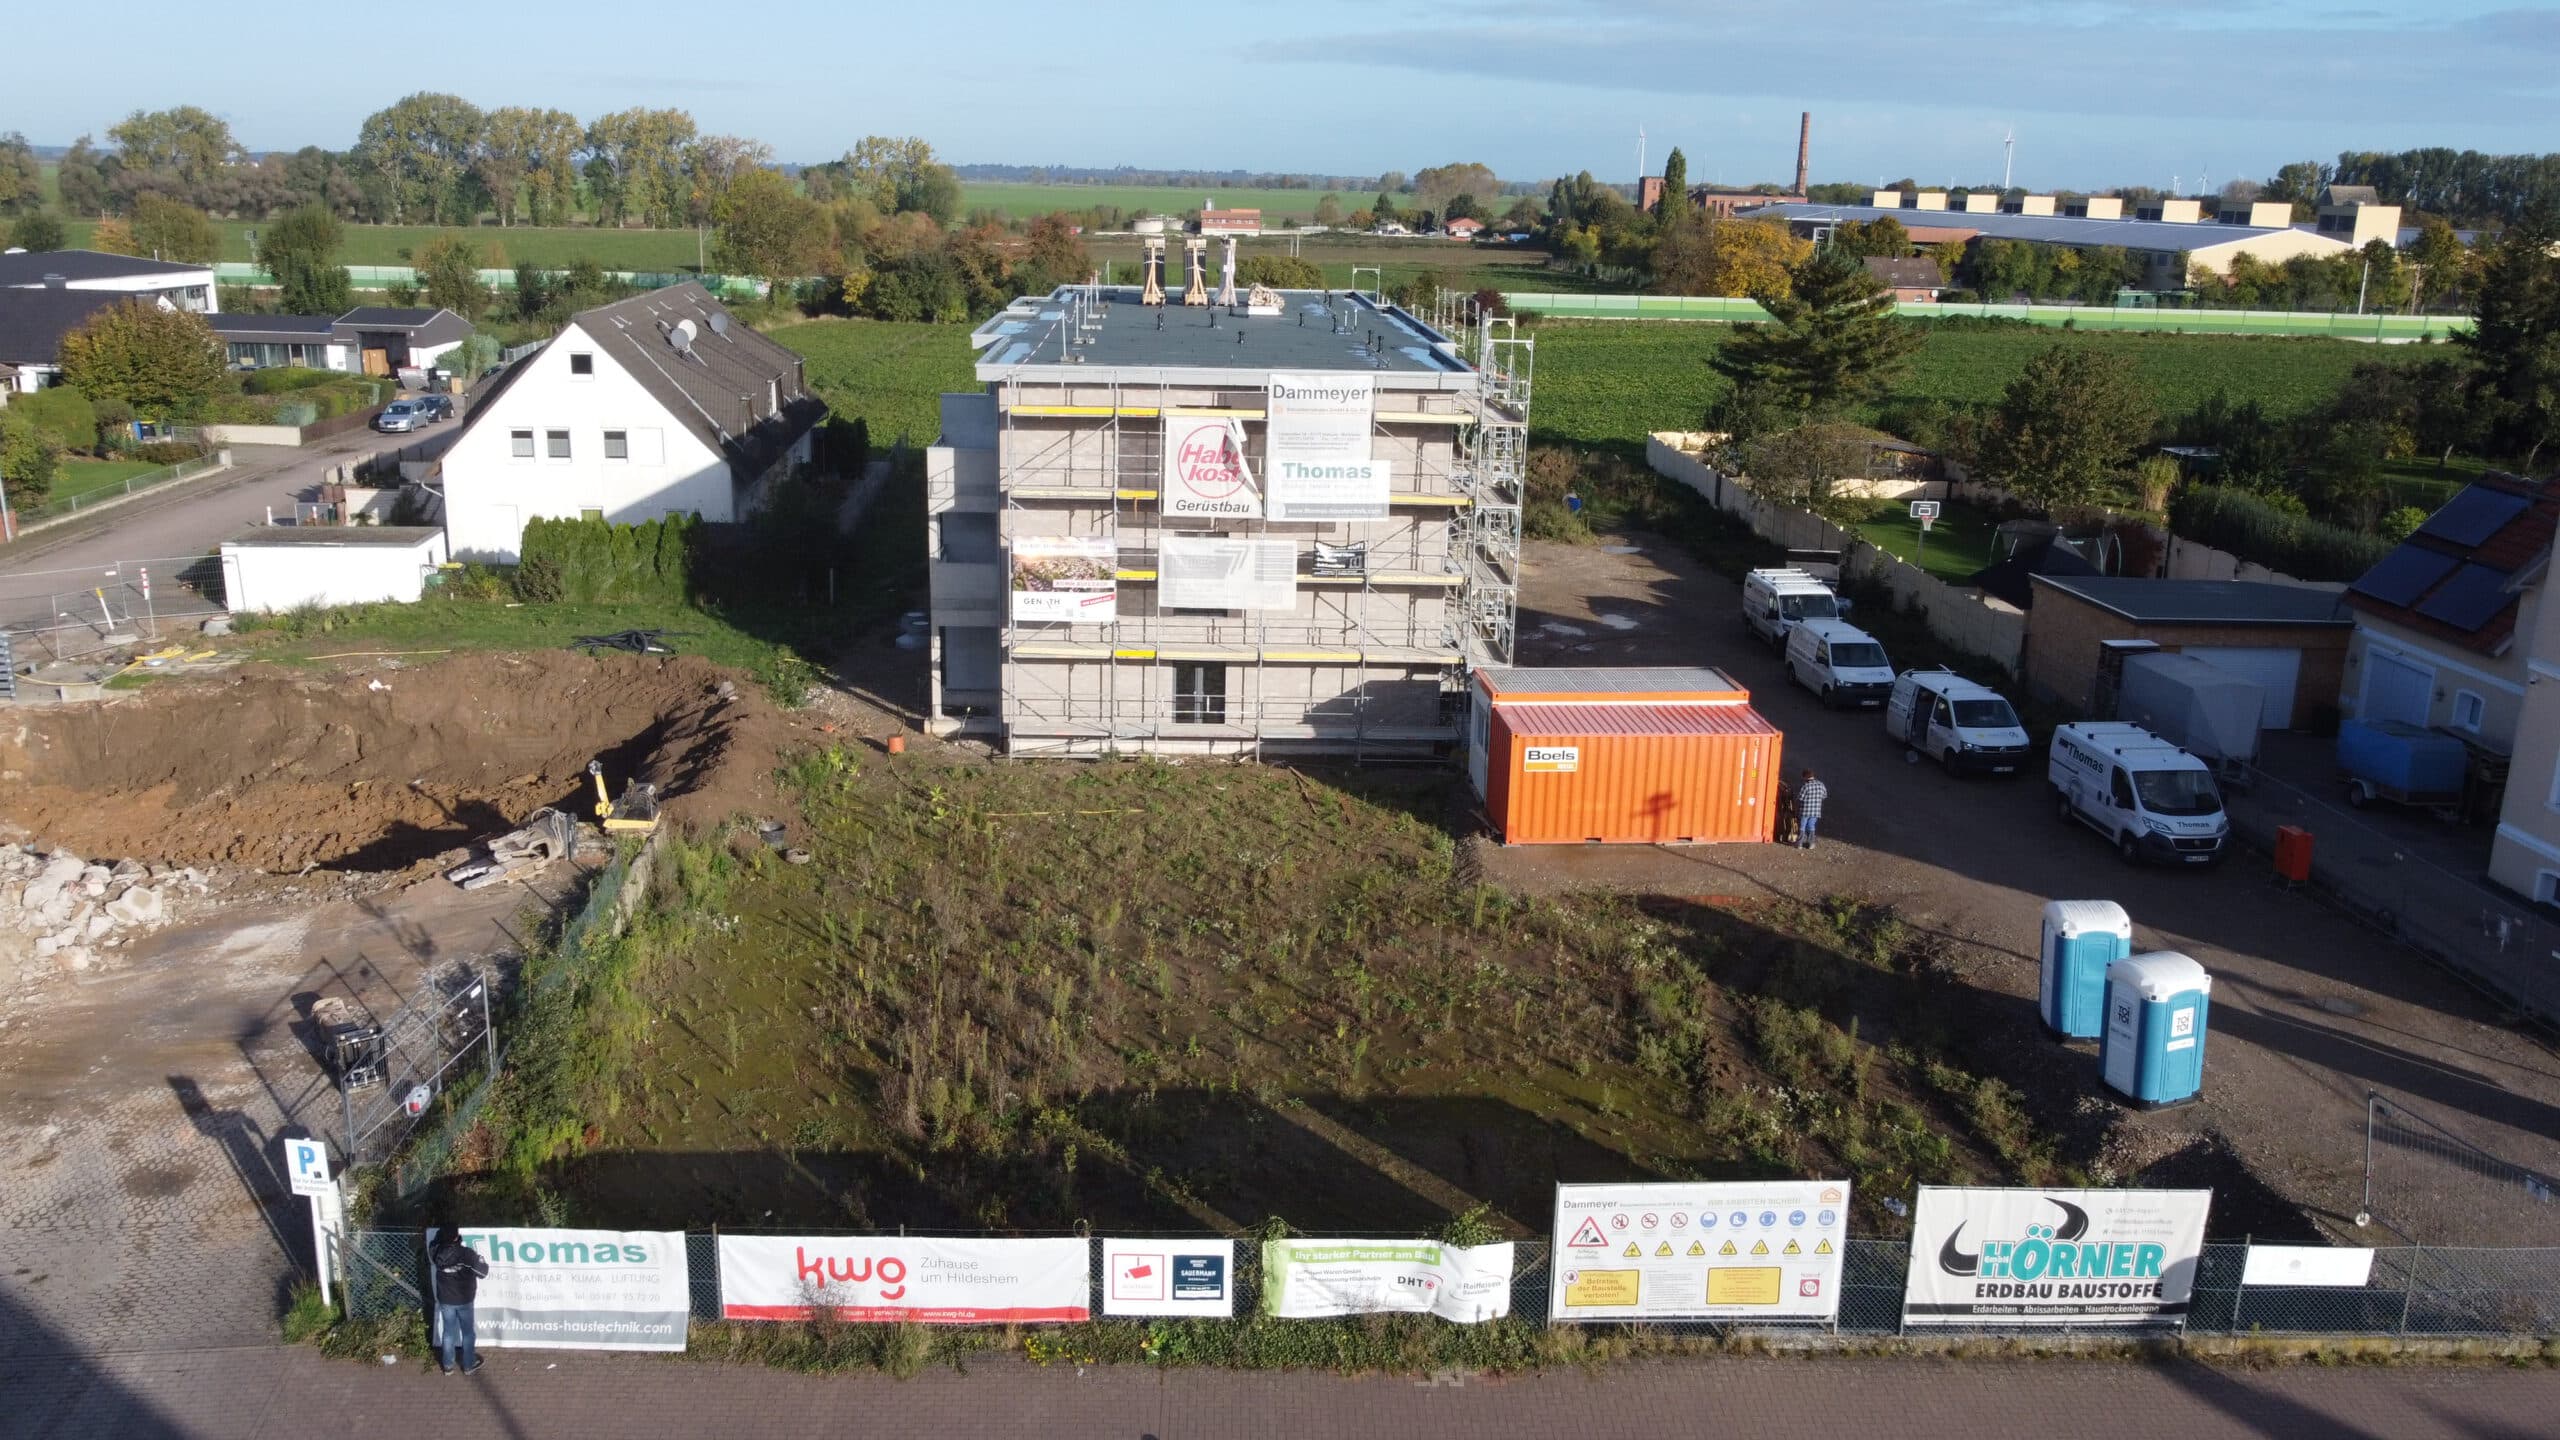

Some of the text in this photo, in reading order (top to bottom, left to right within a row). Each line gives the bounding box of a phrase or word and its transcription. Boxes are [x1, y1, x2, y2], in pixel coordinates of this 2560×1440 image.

[1272, 384, 1369, 404] Dammeyer
[1281, 462, 1372, 479] Thomas
[1175, 499, 1250, 513] Gerüstbau
[1527, 750, 1575, 761] Boels
[2067, 741, 2104, 775] Thomas
[297, 1145, 315, 1174] P
[1563, 1200, 1617, 1209] Dammeyer
[461, 1234, 648, 1264] Thomas
[1295, 1249, 1435, 1261] Ihr starker Partner am Bau
[1977, 1223, 2167, 1282] HÖRNER
[920, 1256, 979, 1270] Zuhause
[796, 1246, 907, 1300] kwg
[920, 1272, 1019, 1285] um Hildeshem
[1397, 1275, 1424, 1288] DHT
[1975, 1282, 2163, 1299] ERDBAU BAUSTOFFE
[1972, 1304, 2018, 1314] Erdarbeiten
[2023, 1304, 2079, 1314] Abrissarbeiten
[2085, 1304, 2160, 1315] Haustrockenlegung
[477, 1319, 672, 1335] www.thomas-haustechnik.com
